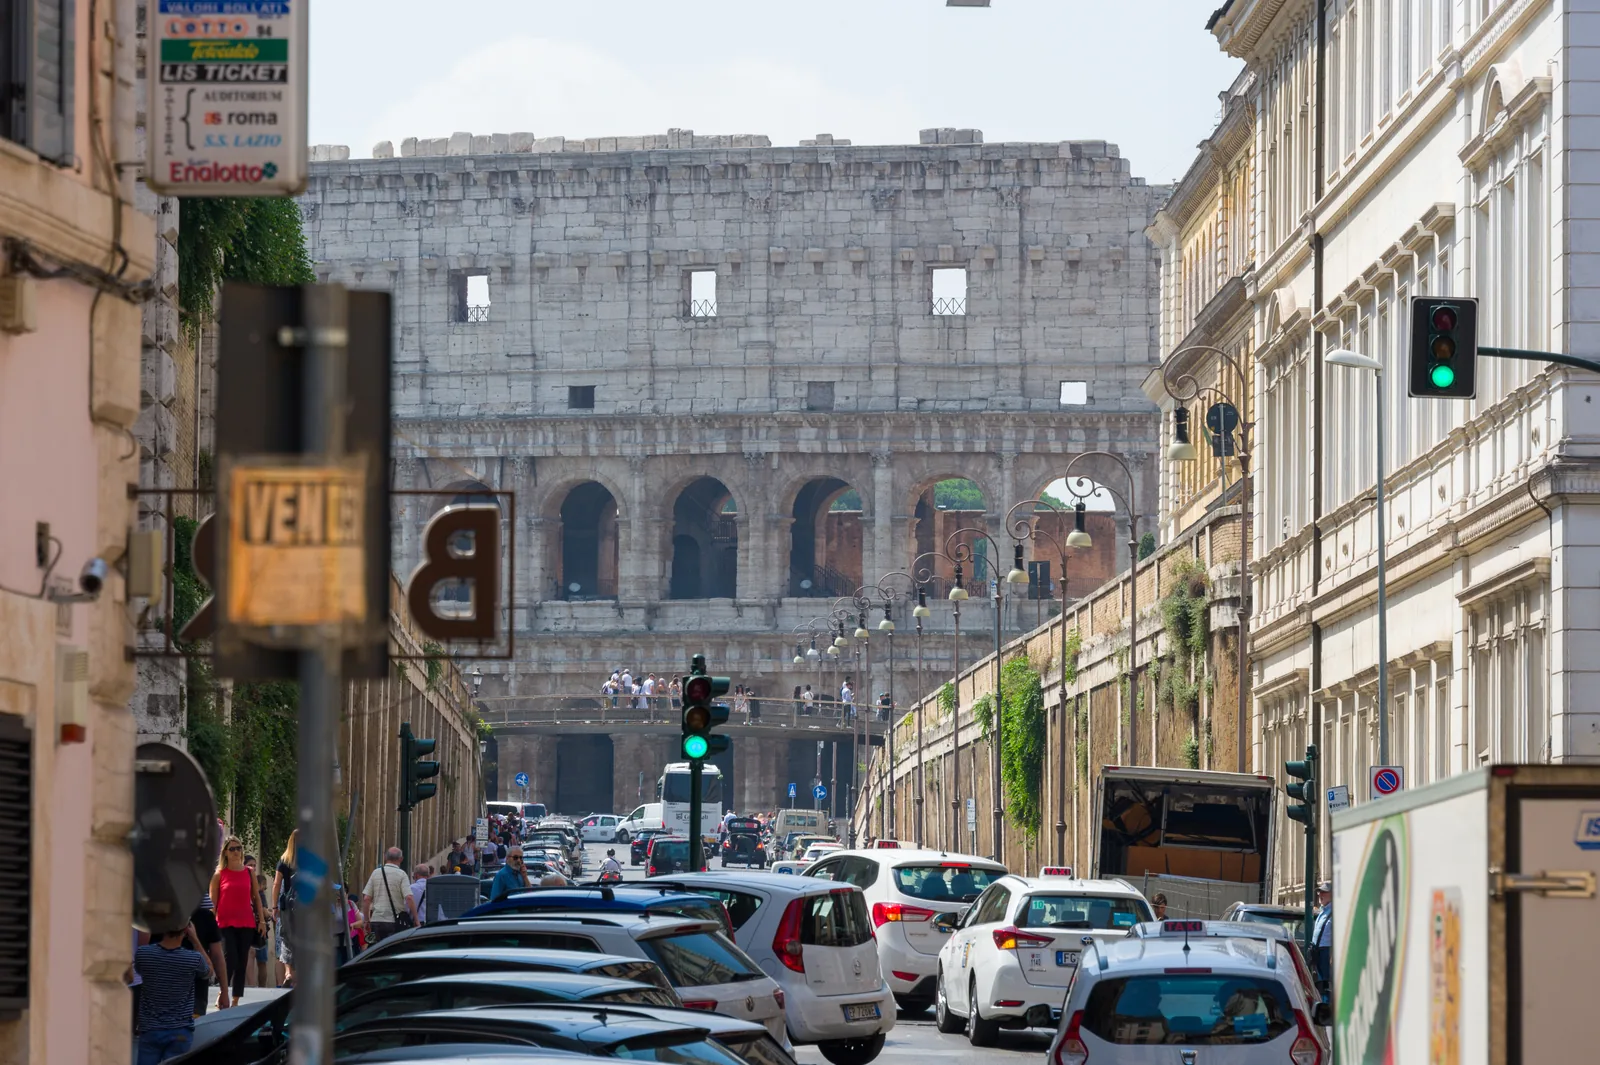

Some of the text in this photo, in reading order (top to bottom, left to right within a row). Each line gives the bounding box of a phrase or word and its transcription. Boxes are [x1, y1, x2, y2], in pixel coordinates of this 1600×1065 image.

[166, 2, 282, 13] VALORI BOLLATI
[163, 65, 285, 80] LIS TICKET
[203, 90, 282, 102] AUDITORIUM
[227, 112, 278, 125] roma
[233, 134, 282, 147] LAZIO
[169, 161, 263, 182] Enalotto
[1045, 868, 1070, 876] TAXI
[1033, 901, 1044, 909] 10
[1165, 921, 1201, 931] TAXI
